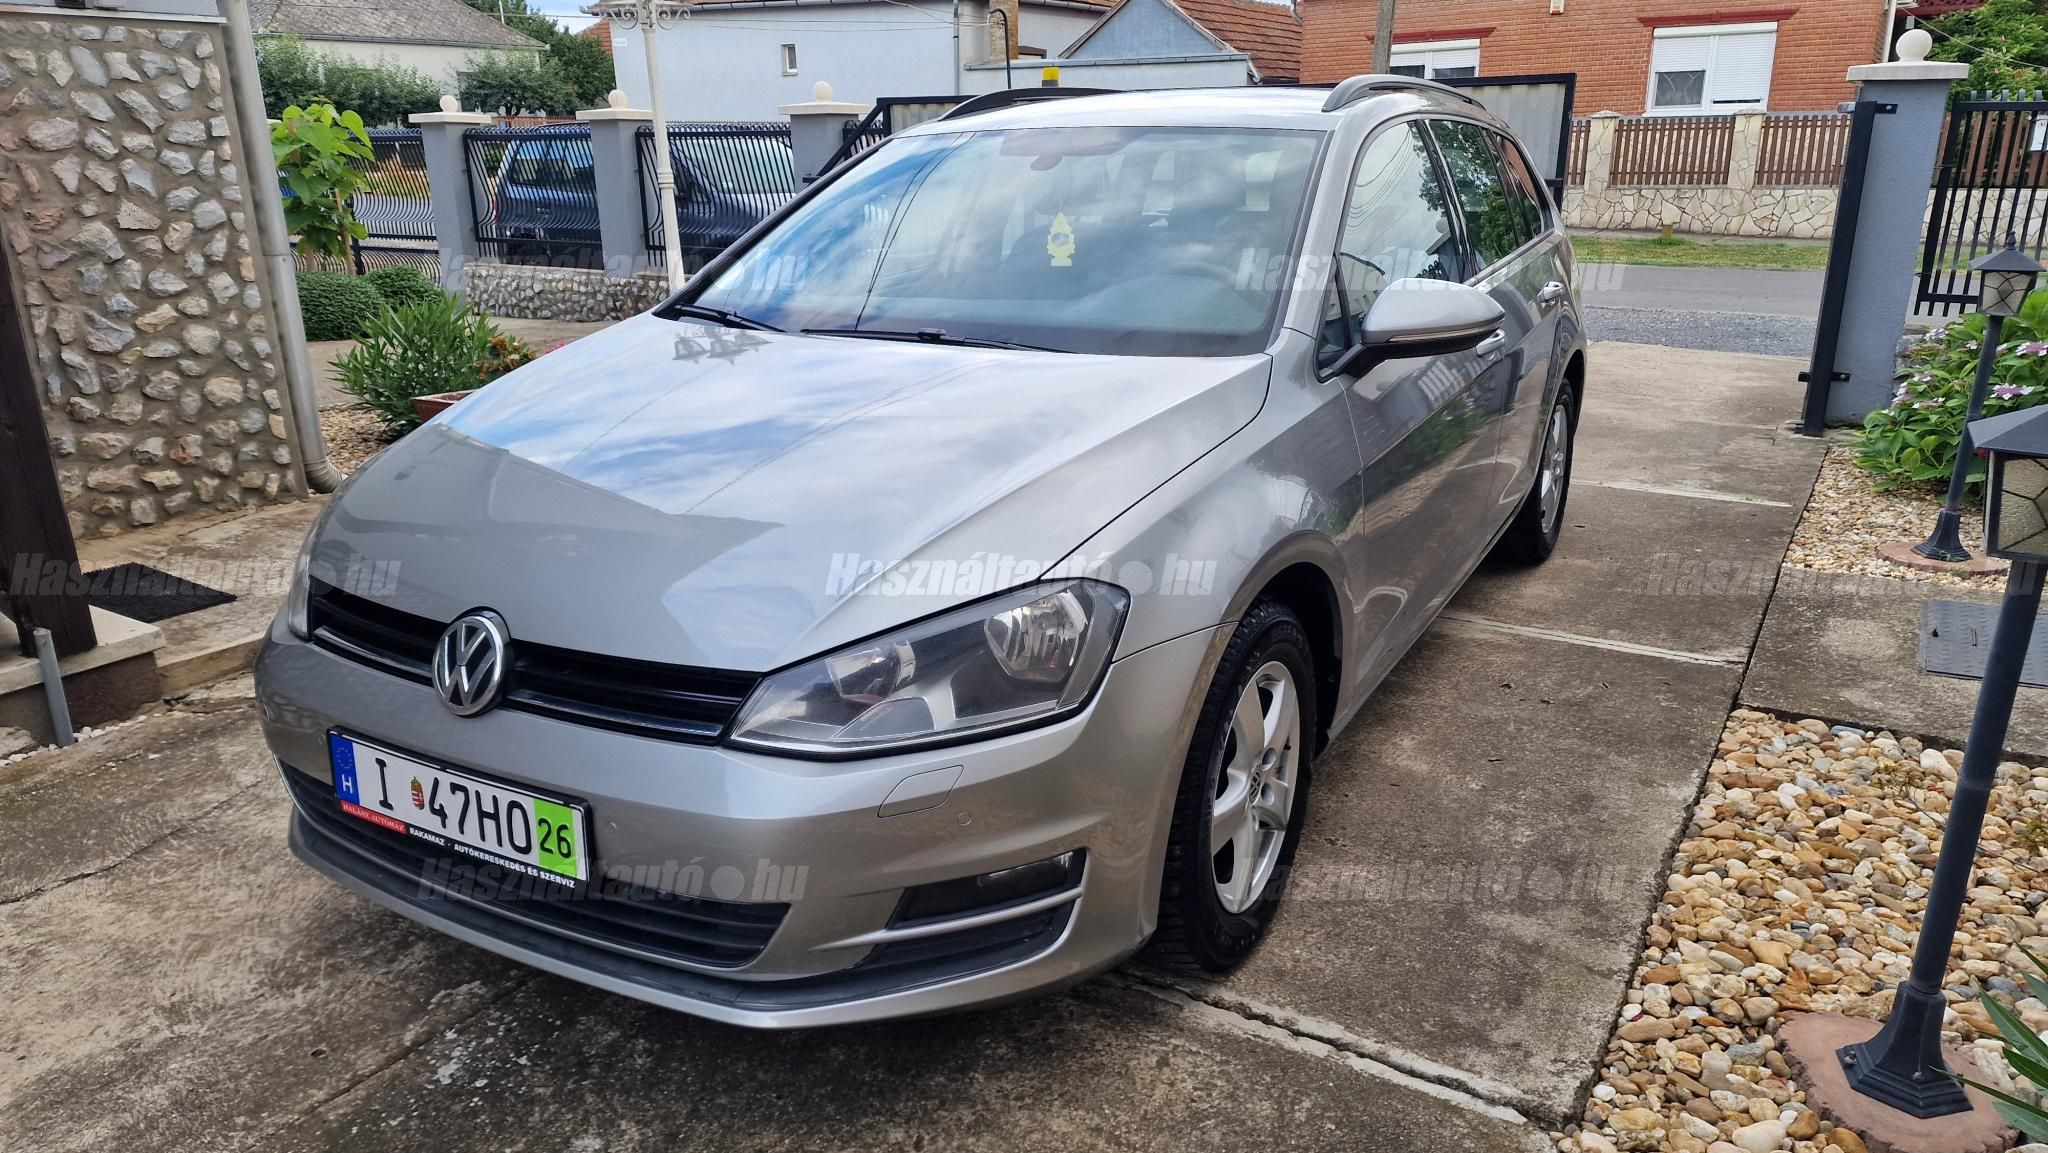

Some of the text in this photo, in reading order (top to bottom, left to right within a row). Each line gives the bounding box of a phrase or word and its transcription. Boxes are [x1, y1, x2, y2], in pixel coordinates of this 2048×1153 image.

[341, 774, 353, 794] H
[409, 828, 446, 847] RAKAMAZ
[454, 843, 526, 873] AUTÓKERESKEDÉS
[527, 866, 539, 878] ÉS
[539, 871, 576, 888] SZERVIZ
[537, 817, 572, 859] 26
